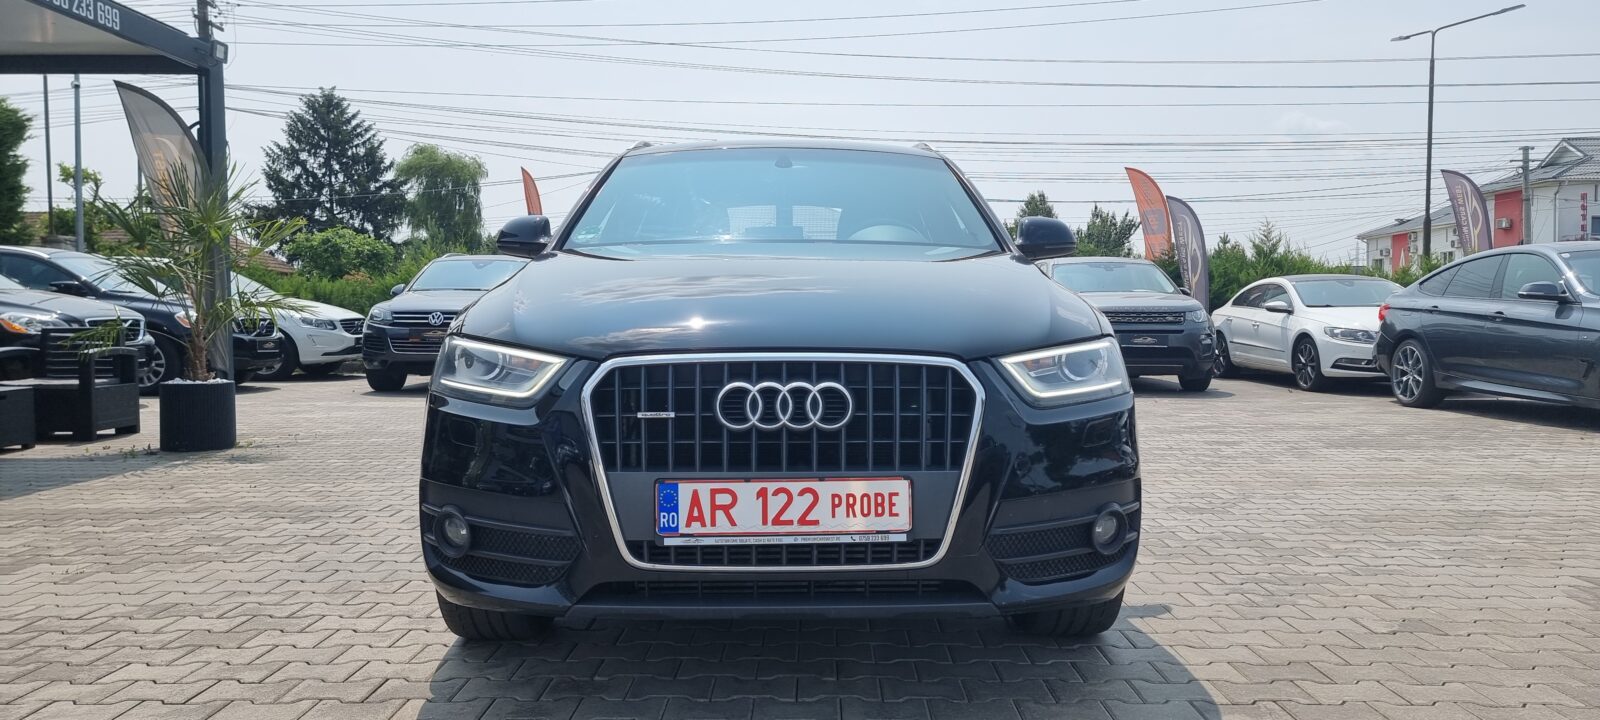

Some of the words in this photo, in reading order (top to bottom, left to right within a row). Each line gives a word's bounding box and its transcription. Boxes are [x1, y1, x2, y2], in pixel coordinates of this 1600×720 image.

[72, 0, 94, 20] 233
[97, 2, 120, 30] 699
[660, 512, 677, 527] RO
[685, 488, 738, 528] AR
[756, 487, 820, 526] 122
[831, 492, 900, 518] PROBE
